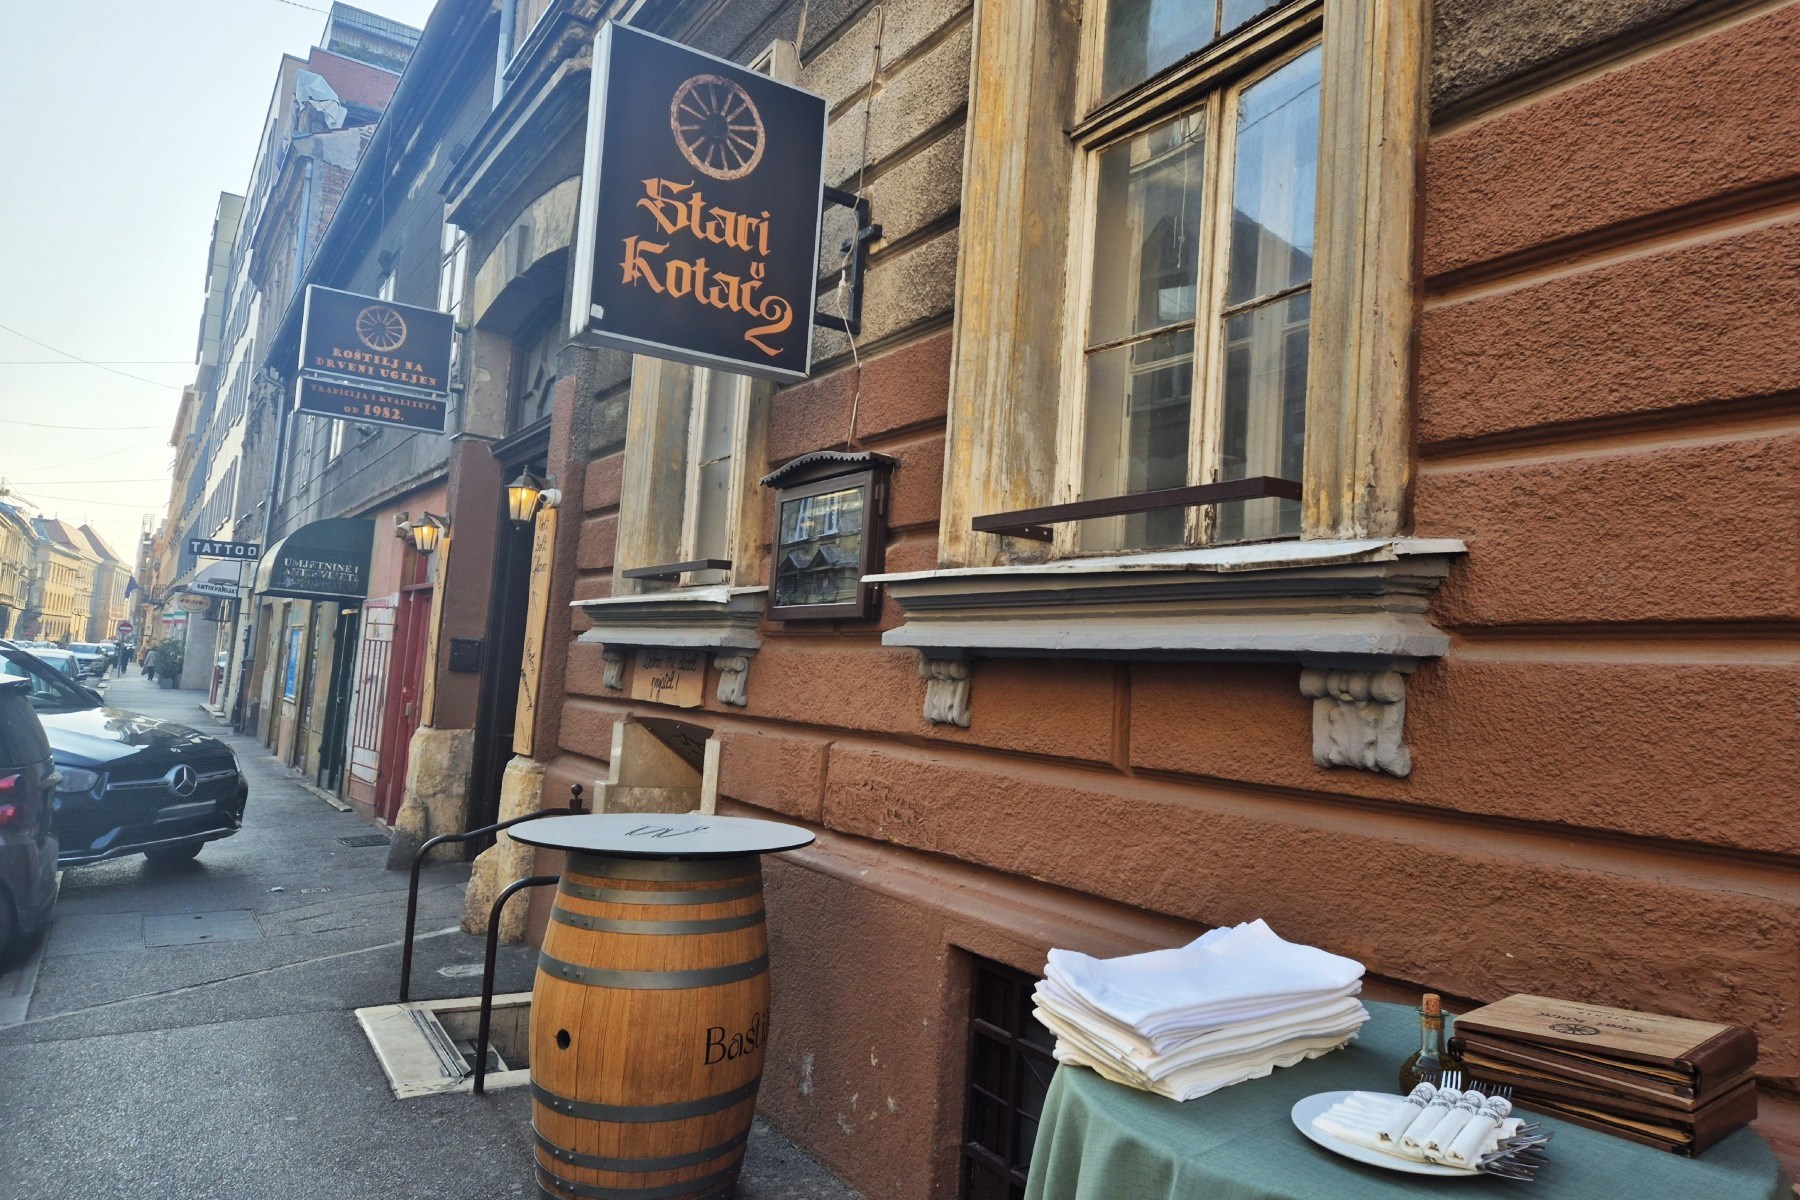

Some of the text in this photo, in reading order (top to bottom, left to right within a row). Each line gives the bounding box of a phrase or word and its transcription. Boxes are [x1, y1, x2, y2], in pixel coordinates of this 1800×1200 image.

[636, 177, 771, 256] Stari
[619, 235, 766, 317] Kotač
[743, 294, 793, 357] 2
[315, 356, 438, 386] DRVENI UGLJEN
[332, 347, 424, 373] ROŠTILJ NA
[310, 383, 437, 411] TRADICIJA I KVALITETA
[343, 404, 404, 421] OD 1982.
[191, 541, 257, 556] TATTOO
[284, 557, 359, 574] UMJETNINE I
